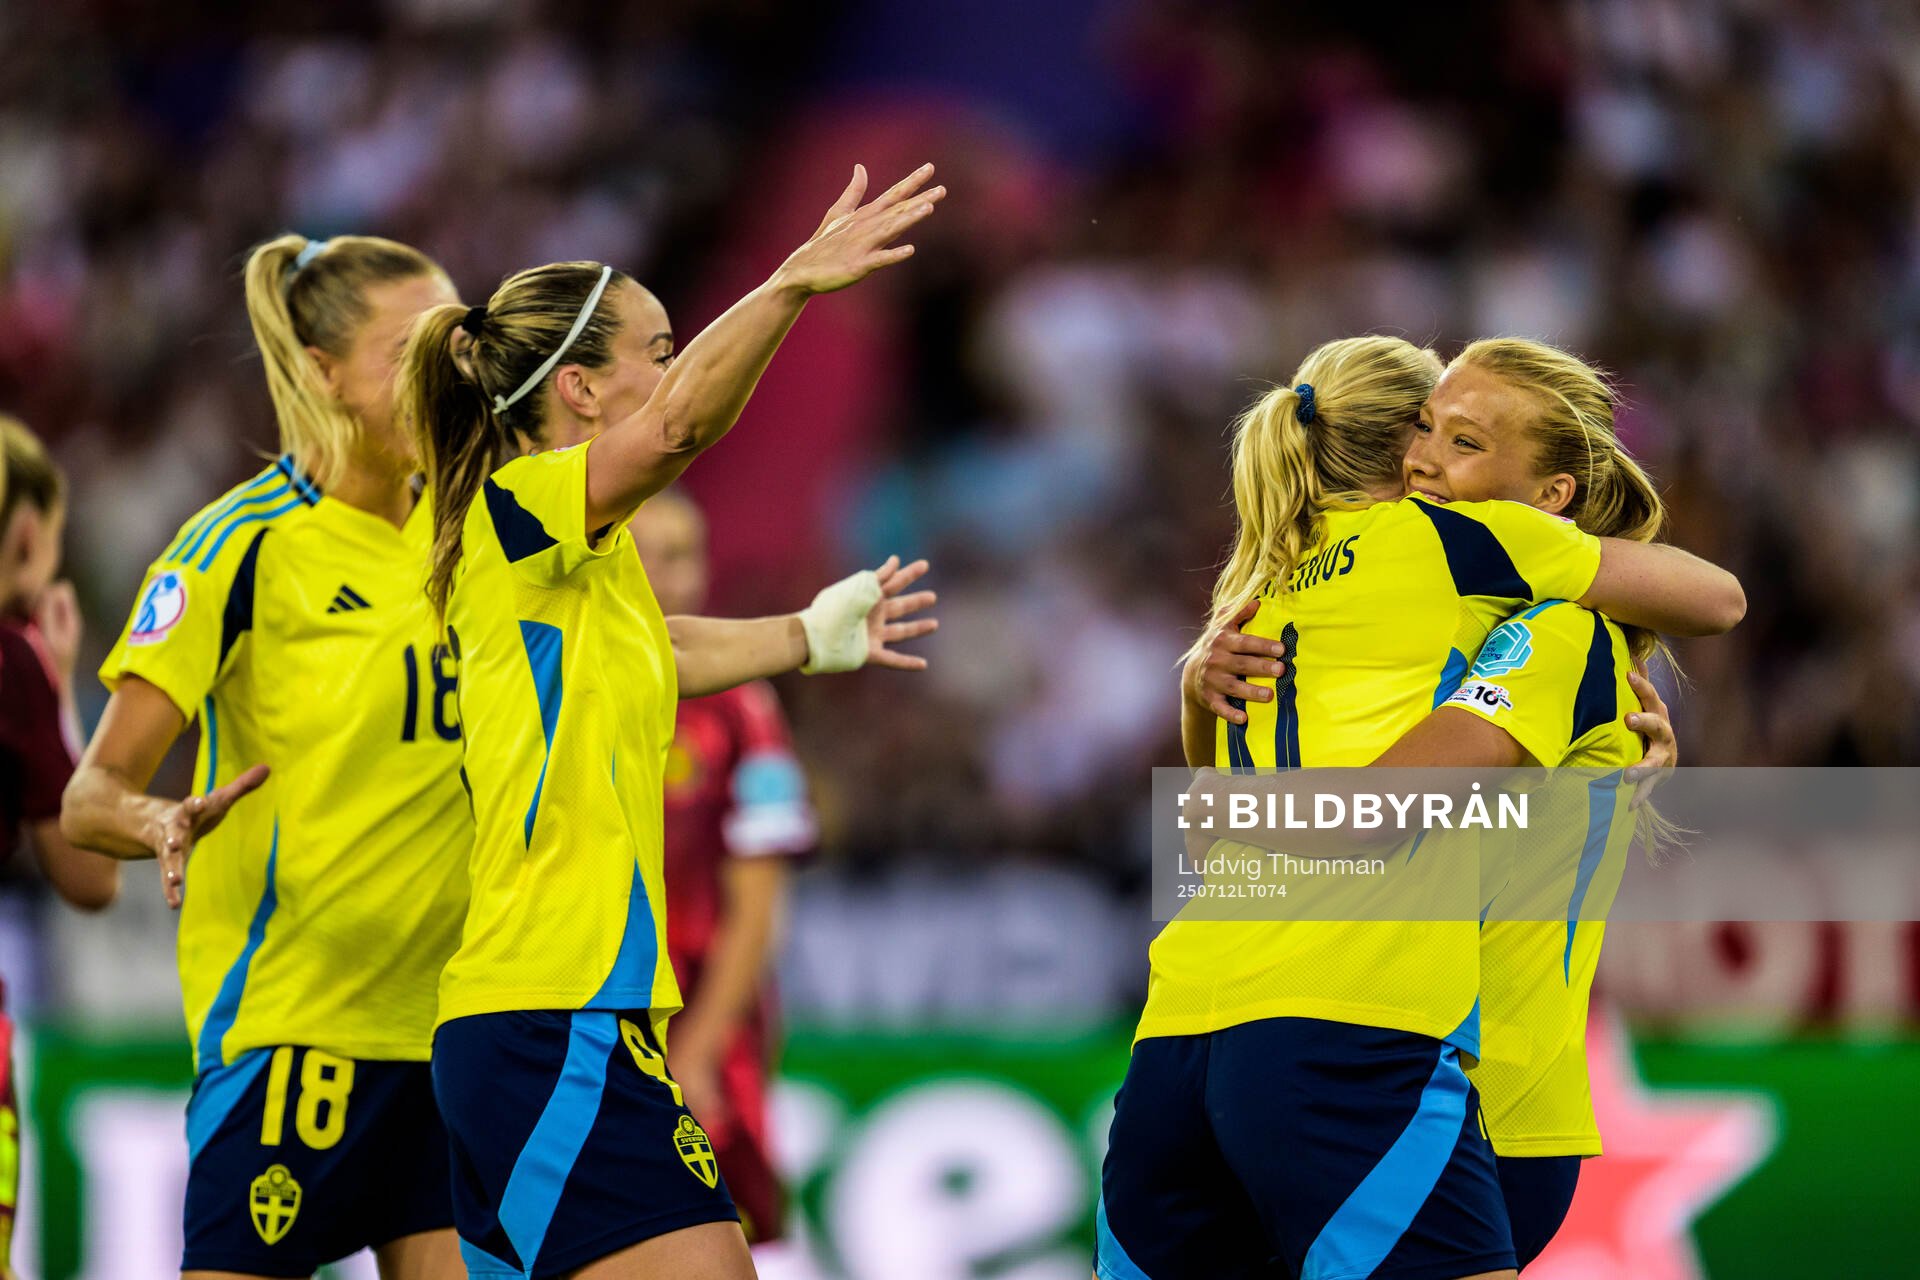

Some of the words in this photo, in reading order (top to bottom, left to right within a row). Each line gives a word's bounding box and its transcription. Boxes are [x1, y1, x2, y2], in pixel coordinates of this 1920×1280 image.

[401, 642, 461, 742] 18
[1474, 685, 1500, 706] 10
[260, 1046, 356, 1150] 18
